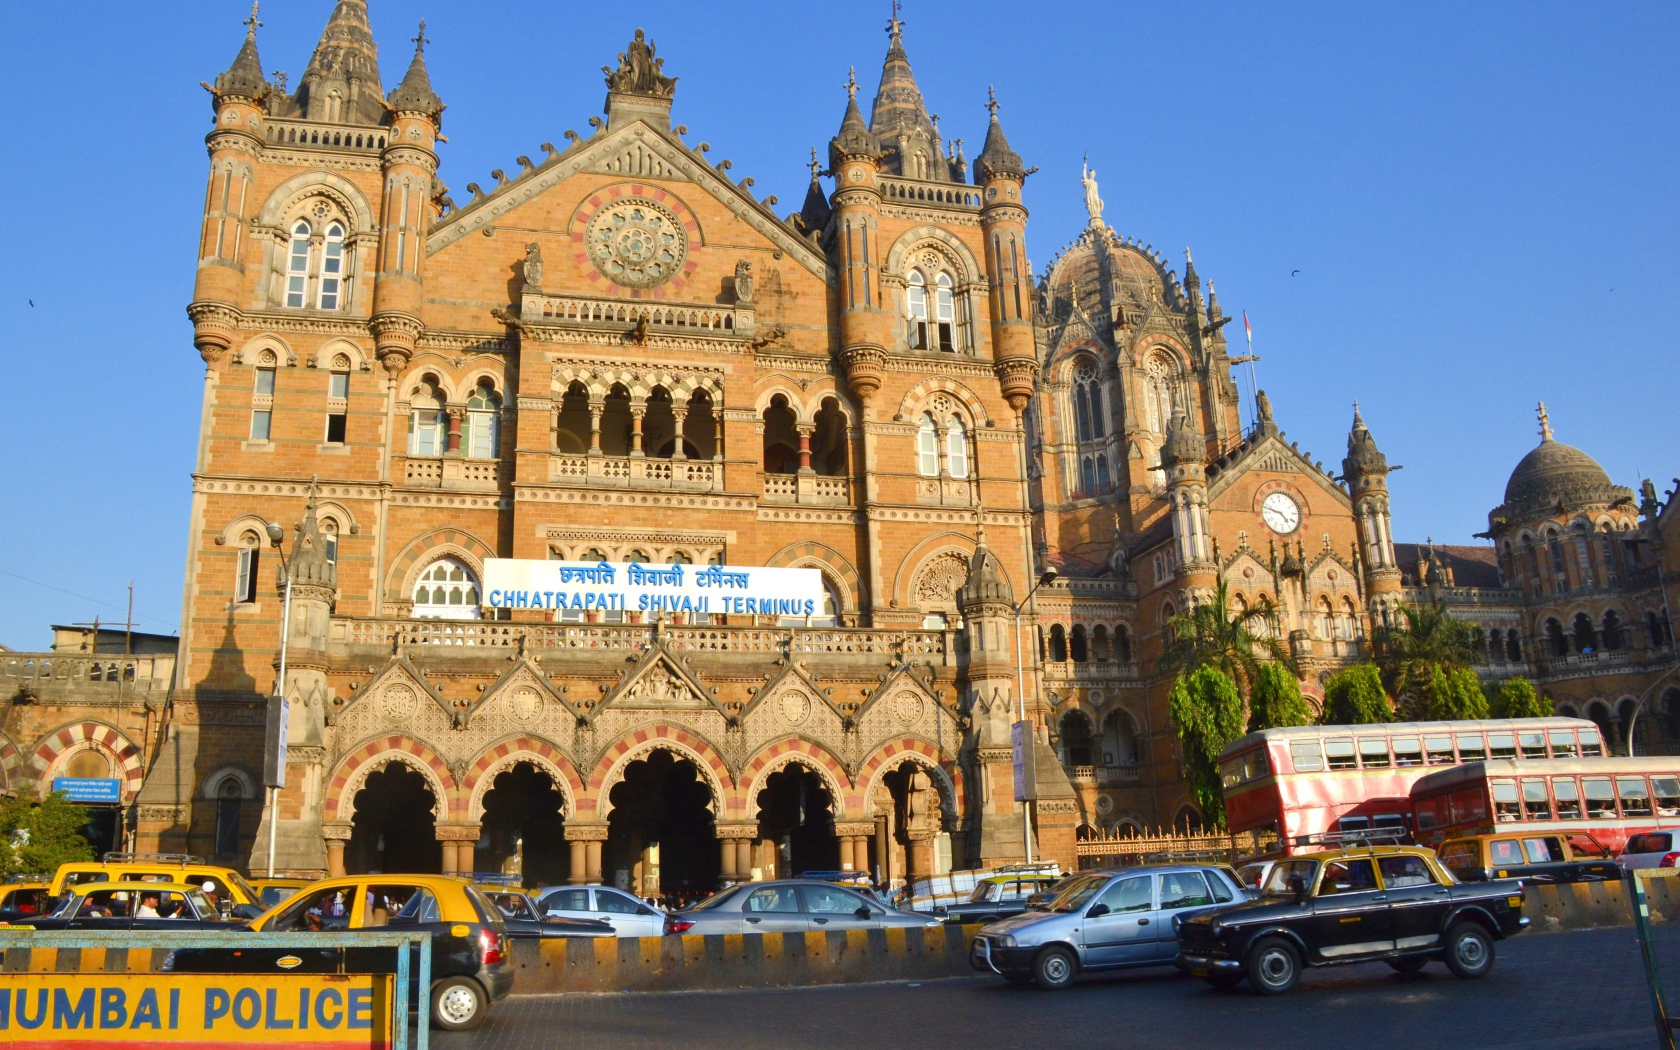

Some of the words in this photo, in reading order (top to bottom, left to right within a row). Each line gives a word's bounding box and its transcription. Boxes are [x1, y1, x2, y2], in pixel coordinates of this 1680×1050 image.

[560, 561, 616, 584] छत्रपति
[628, 562, 684, 586] शिवाजी
[489, 589, 626, 610] CHHATRAPATI
[639, 593, 709, 612] SHIVAJI
[723, 595, 815, 615] TERMINUS
[0, 988, 180, 1030] UMBAI
[204, 987, 375, 1030] POLICE
